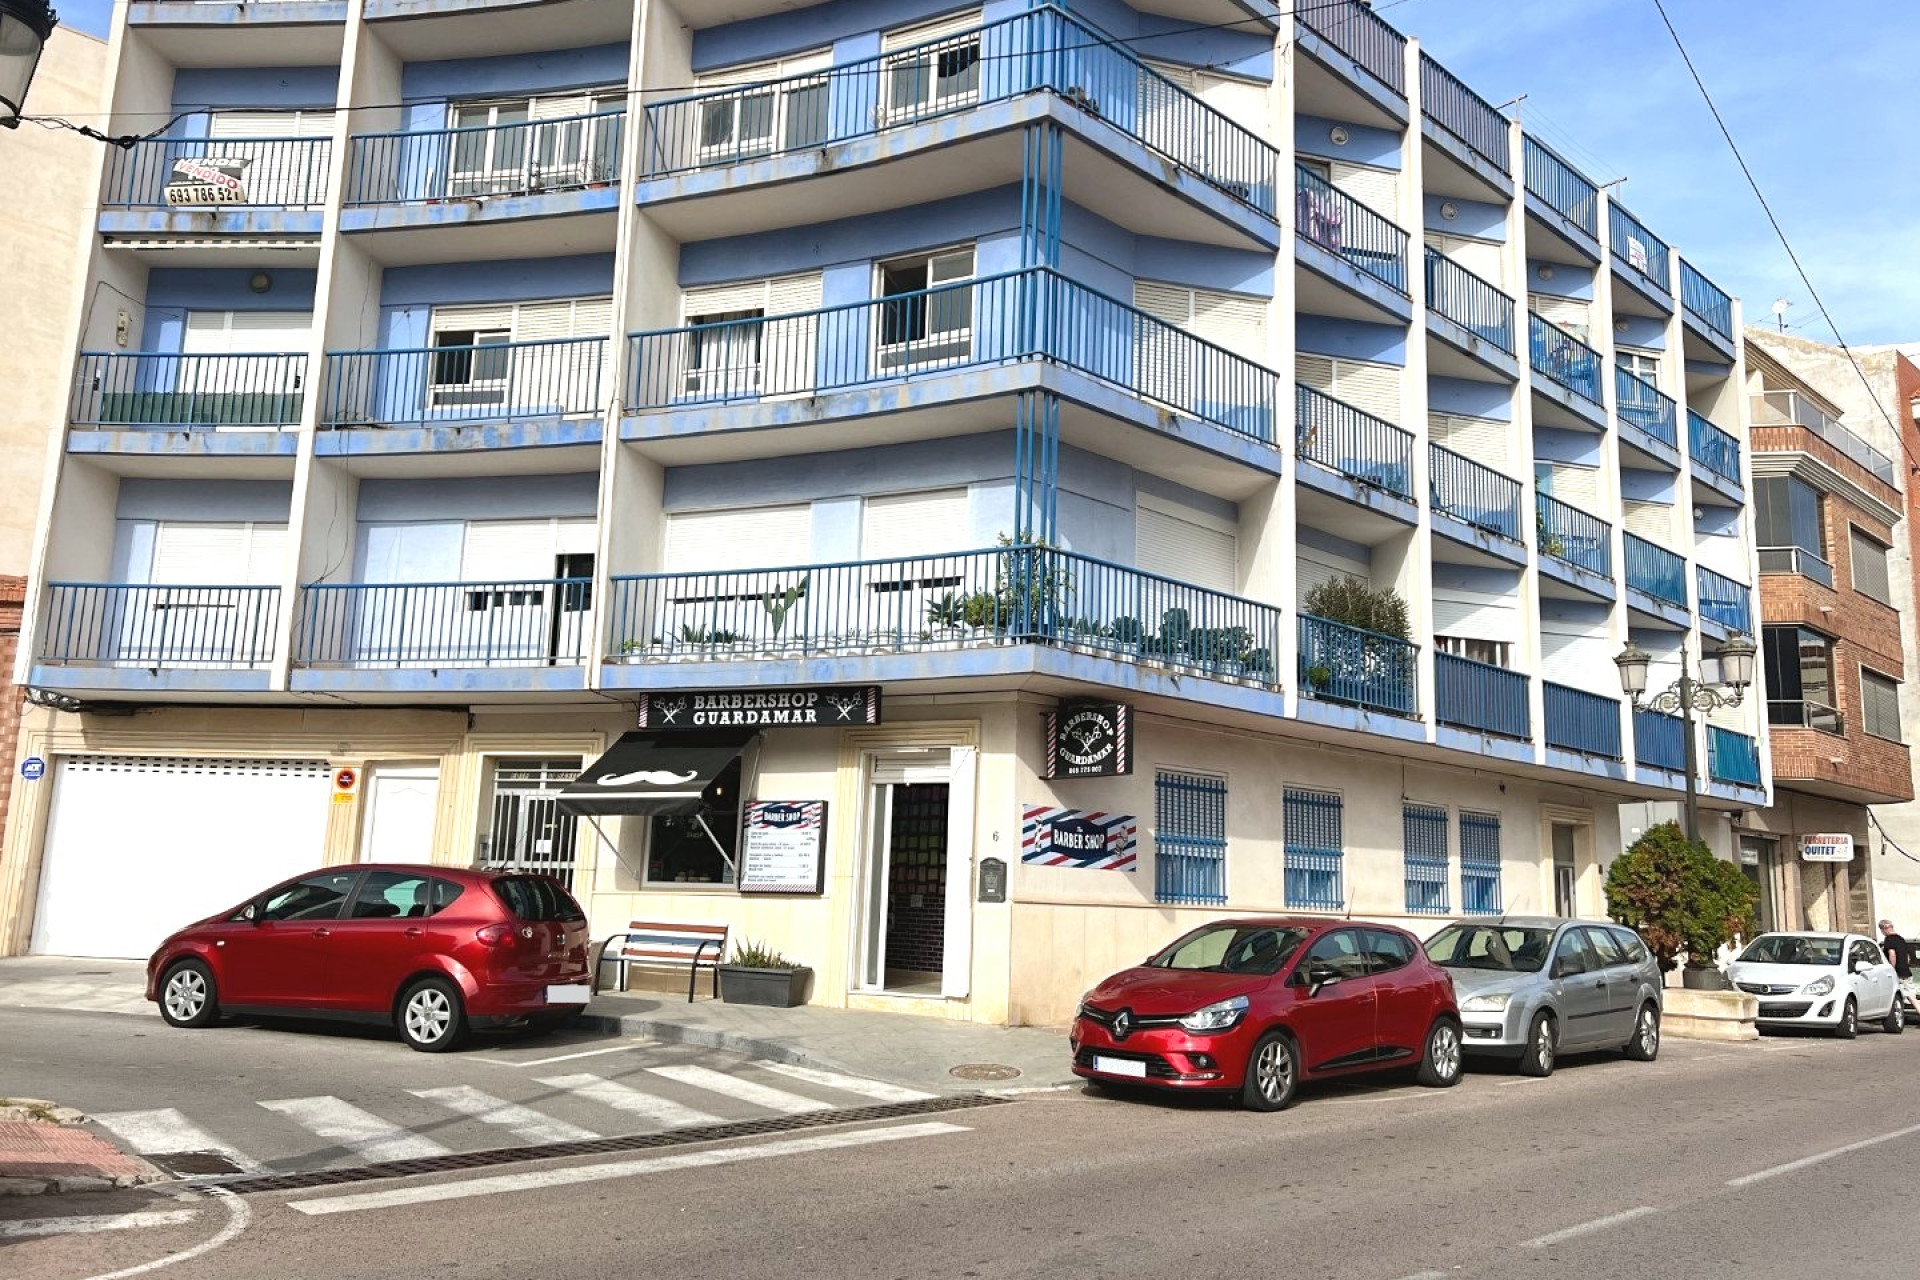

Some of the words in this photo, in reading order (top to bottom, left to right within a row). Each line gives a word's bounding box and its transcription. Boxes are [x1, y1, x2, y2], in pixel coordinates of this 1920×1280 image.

[180, 162, 238, 189] VENDIDO
[170, 187, 192, 203] 693
[193, 187, 215, 202] 786
[694, 692, 818, 709] BARBERSHOP
[693, 709, 817, 725] GUARDAMAR
[1060, 711, 1114, 741] BARBERSHOP
[1060, 743, 1114, 765] GUARDAMAR
[763, 811, 785, 822] BARBER
[786, 811, 801, 822] SHOP
[992, 830, 1000, 842] 6
[1054, 829, 1084, 849] BARBER
[1085, 834, 1105, 849] SHOP
[1804, 845, 1836, 856] QUITET
